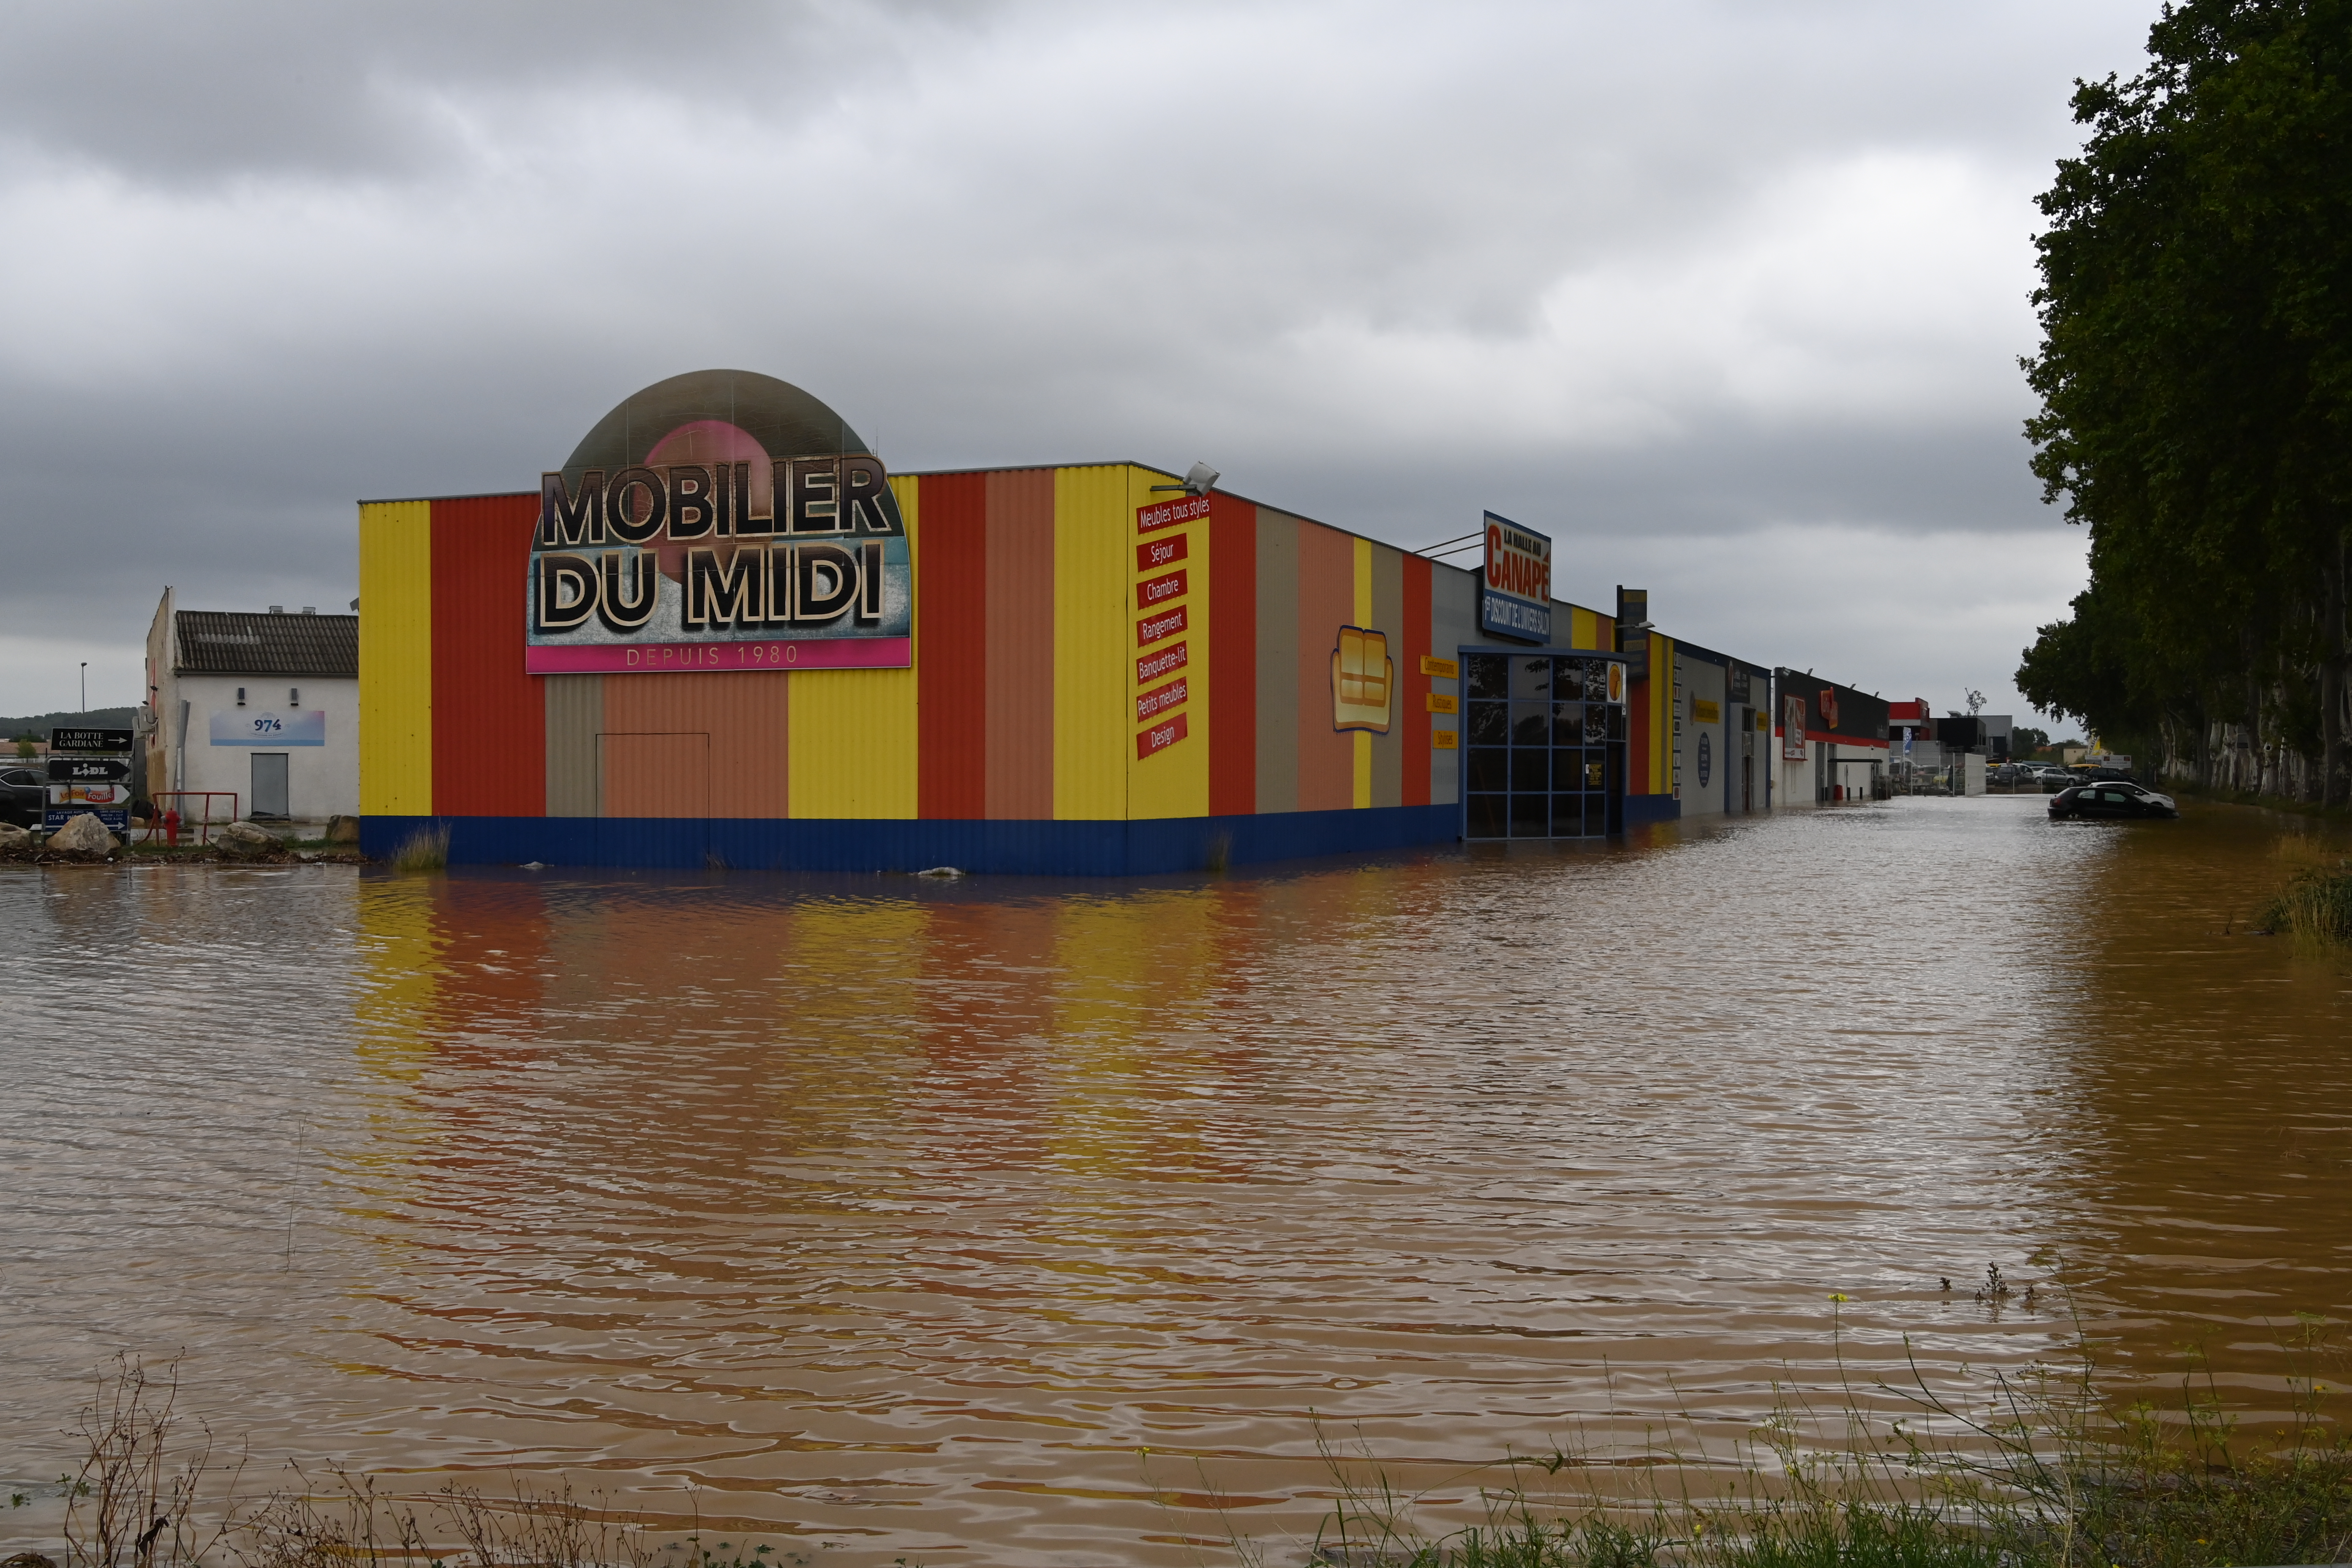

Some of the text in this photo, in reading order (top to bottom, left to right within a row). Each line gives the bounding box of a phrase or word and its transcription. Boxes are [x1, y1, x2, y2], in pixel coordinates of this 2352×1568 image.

[541, 454, 892, 546] MOBILIER
[1141, 497, 1209, 528] Meubles tous styles
[1151, 542, 1173, 564] Séjour
[1504, 529, 1541, 557] LA HALLE AU
[1487, 525, 1549, 602] CANAPÉ
[539, 539, 885, 628] DU MIDI
[1147, 578, 1179, 601] Chambre
[1491, 597, 1511, 626] DISCOUNT
[1512, 603, 1518, 628] DE
[1143, 612, 1182, 639] Rangement
[626, 645, 798, 666] DEPUIS 1980
[1139, 646, 1186, 679] Banquette-lit
[1424, 656, 1454, 676] Contemporains
[1138, 684, 1186, 717] Petits meubles
[1433, 695, 1452, 710] Rustiques
[74, 732, 103, 740] BOTTE
[255, 719, 281, 732] 974
[1151, 726, 1174, 749] Design
[59, 740, 103, 748] GARDIANE
